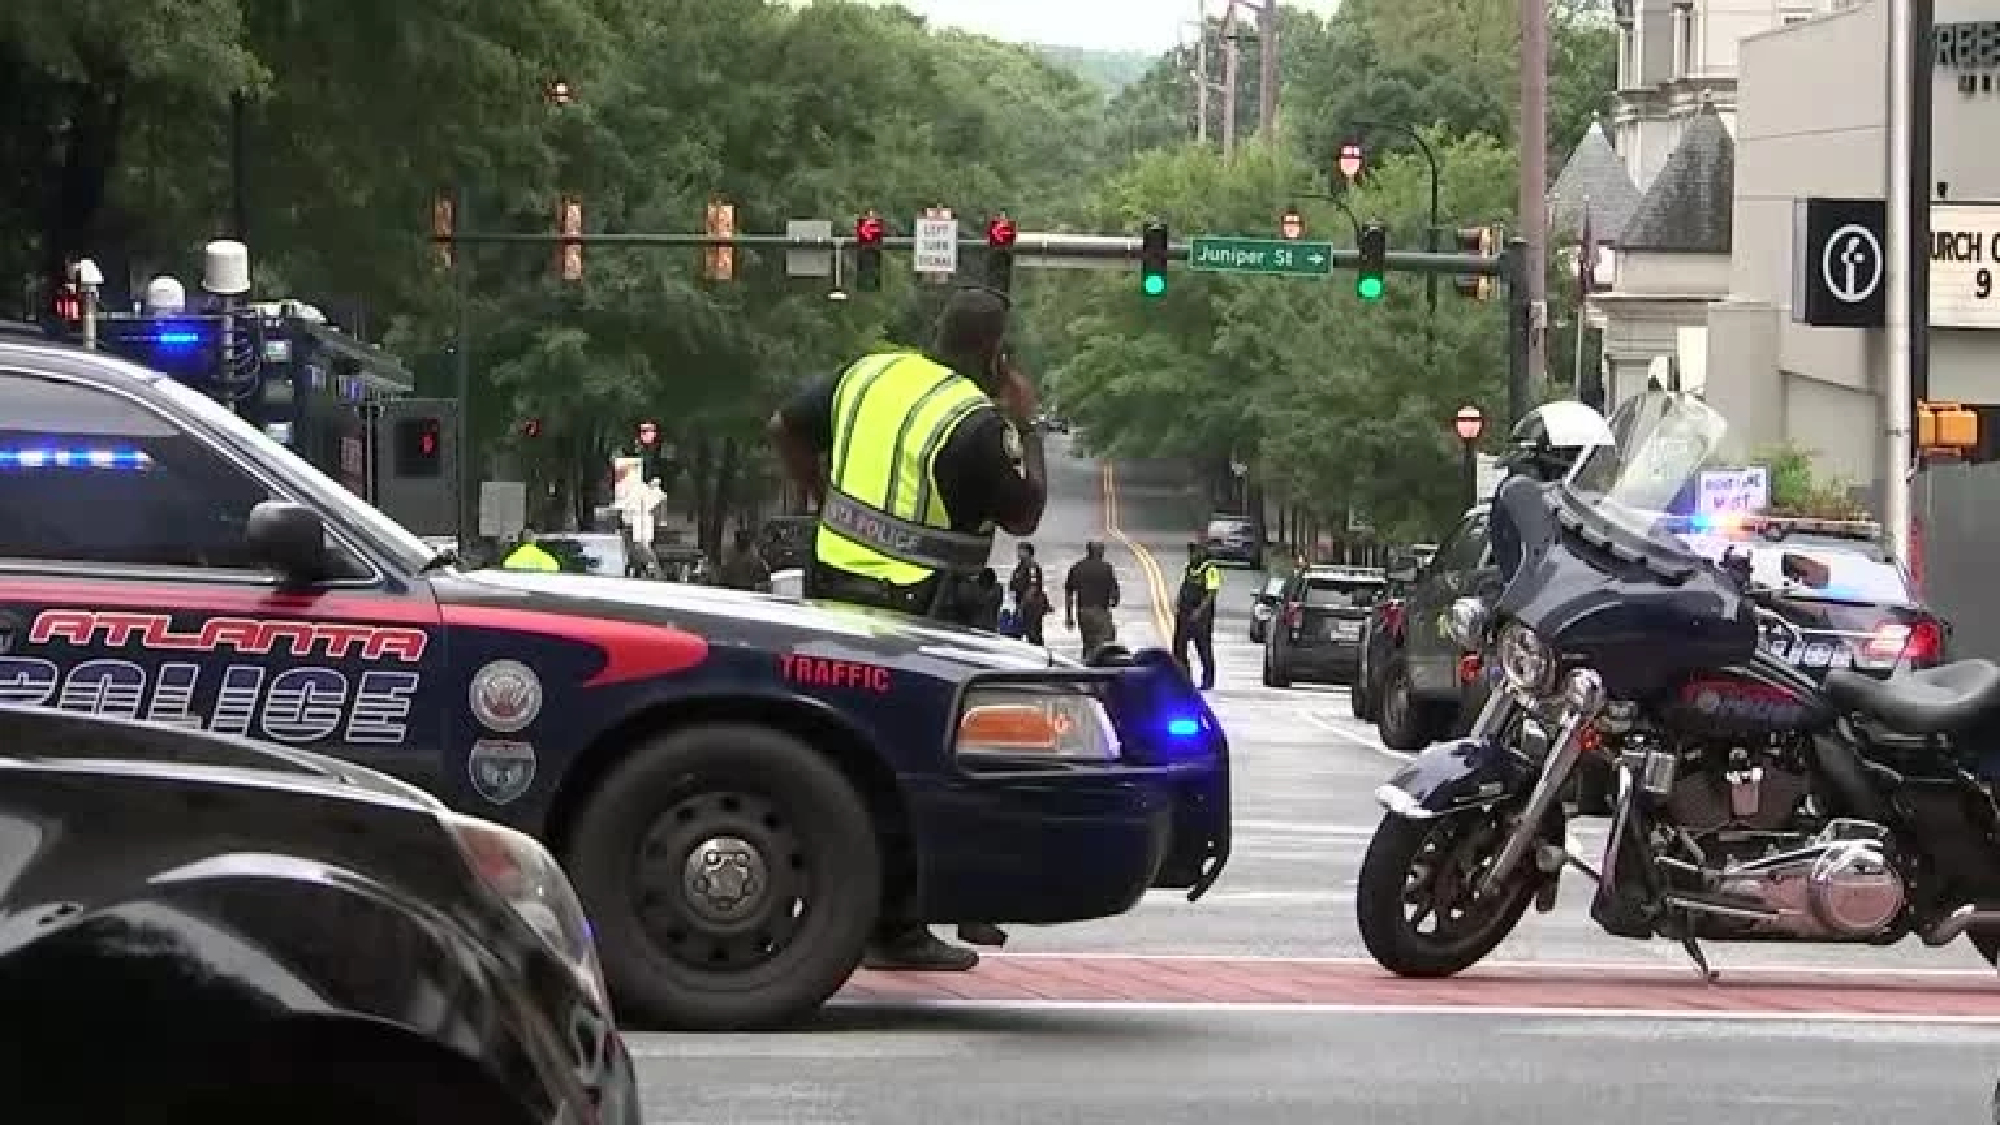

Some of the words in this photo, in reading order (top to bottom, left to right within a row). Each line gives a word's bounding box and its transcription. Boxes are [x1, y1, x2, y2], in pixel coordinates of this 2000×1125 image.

[1197, 244, 1265, 267] Juniper
[1272, 249, 1293, 267] St
[1974, 267, 1992, 299] 9
[855, 514, 920, 550] POLICE
[29, 609, 428, 662] ATLANTA
[780, 655, 889, 691] TRAFFIC
